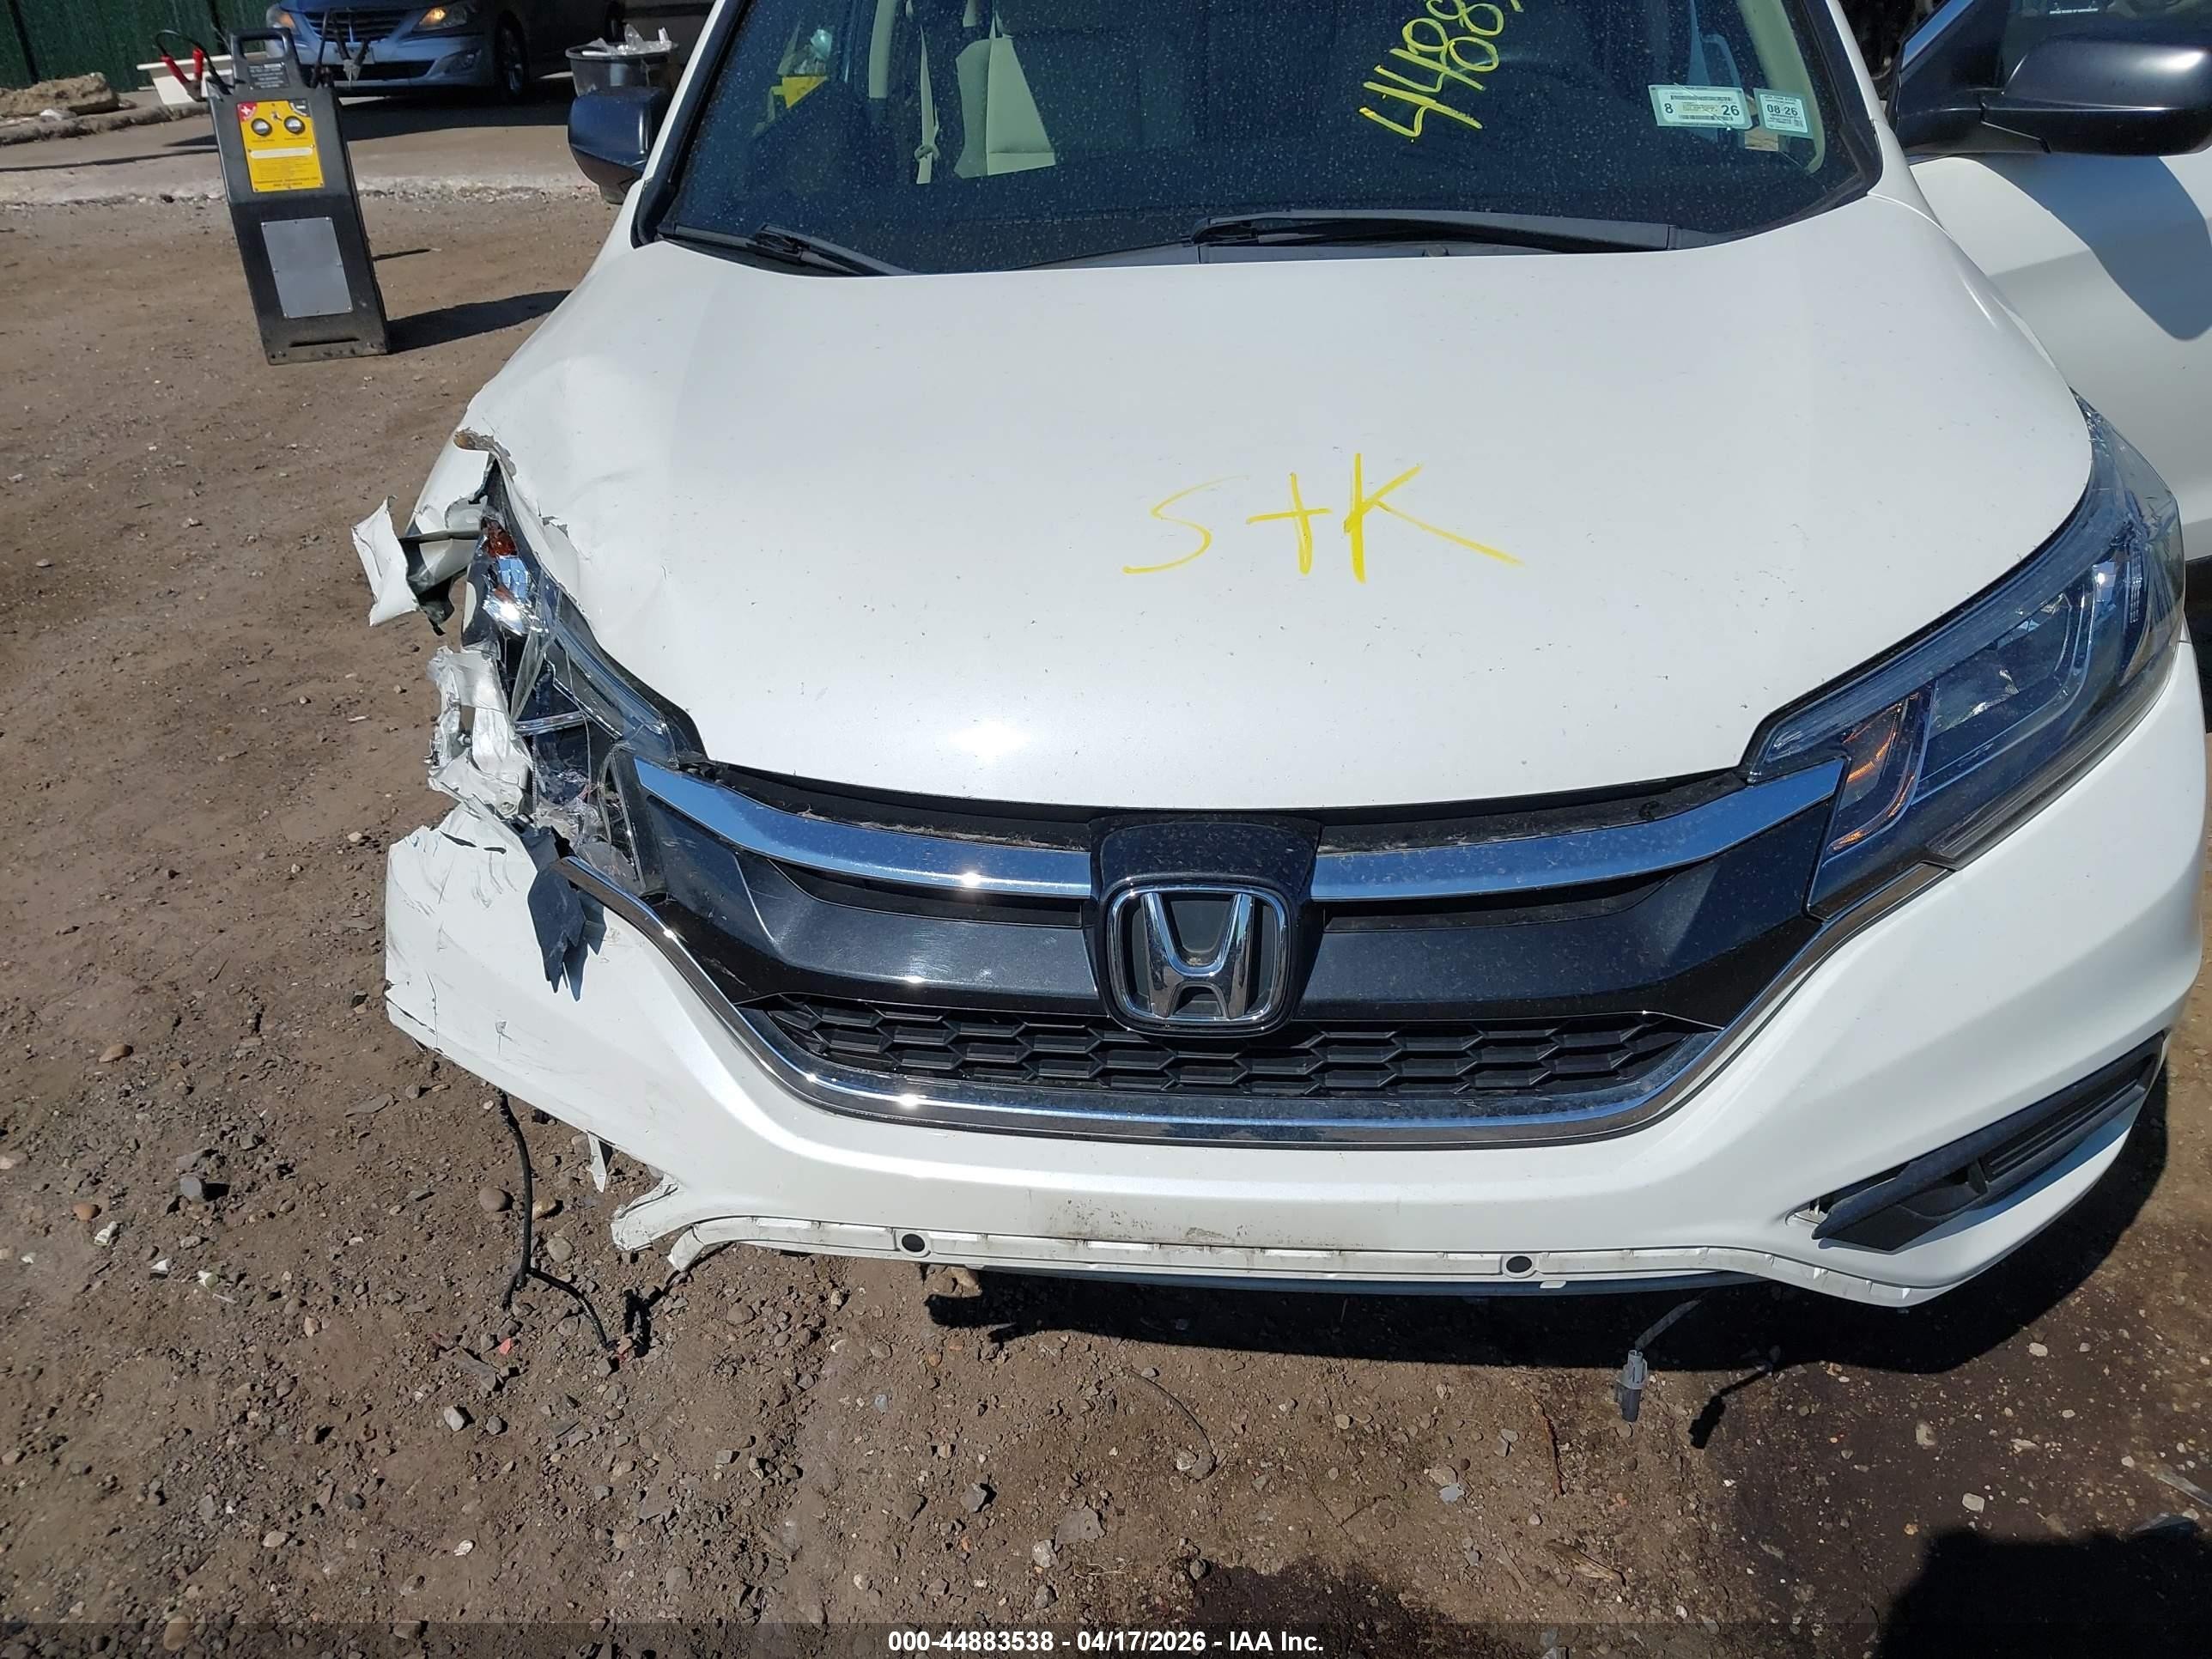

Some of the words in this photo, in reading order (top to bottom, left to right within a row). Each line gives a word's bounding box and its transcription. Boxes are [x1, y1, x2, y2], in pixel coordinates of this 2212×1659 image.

[1358, 0, 1524, 137] 4488
[1664, 102, 1674, 114] 8
[1721, 104, 1740, 116] 26
